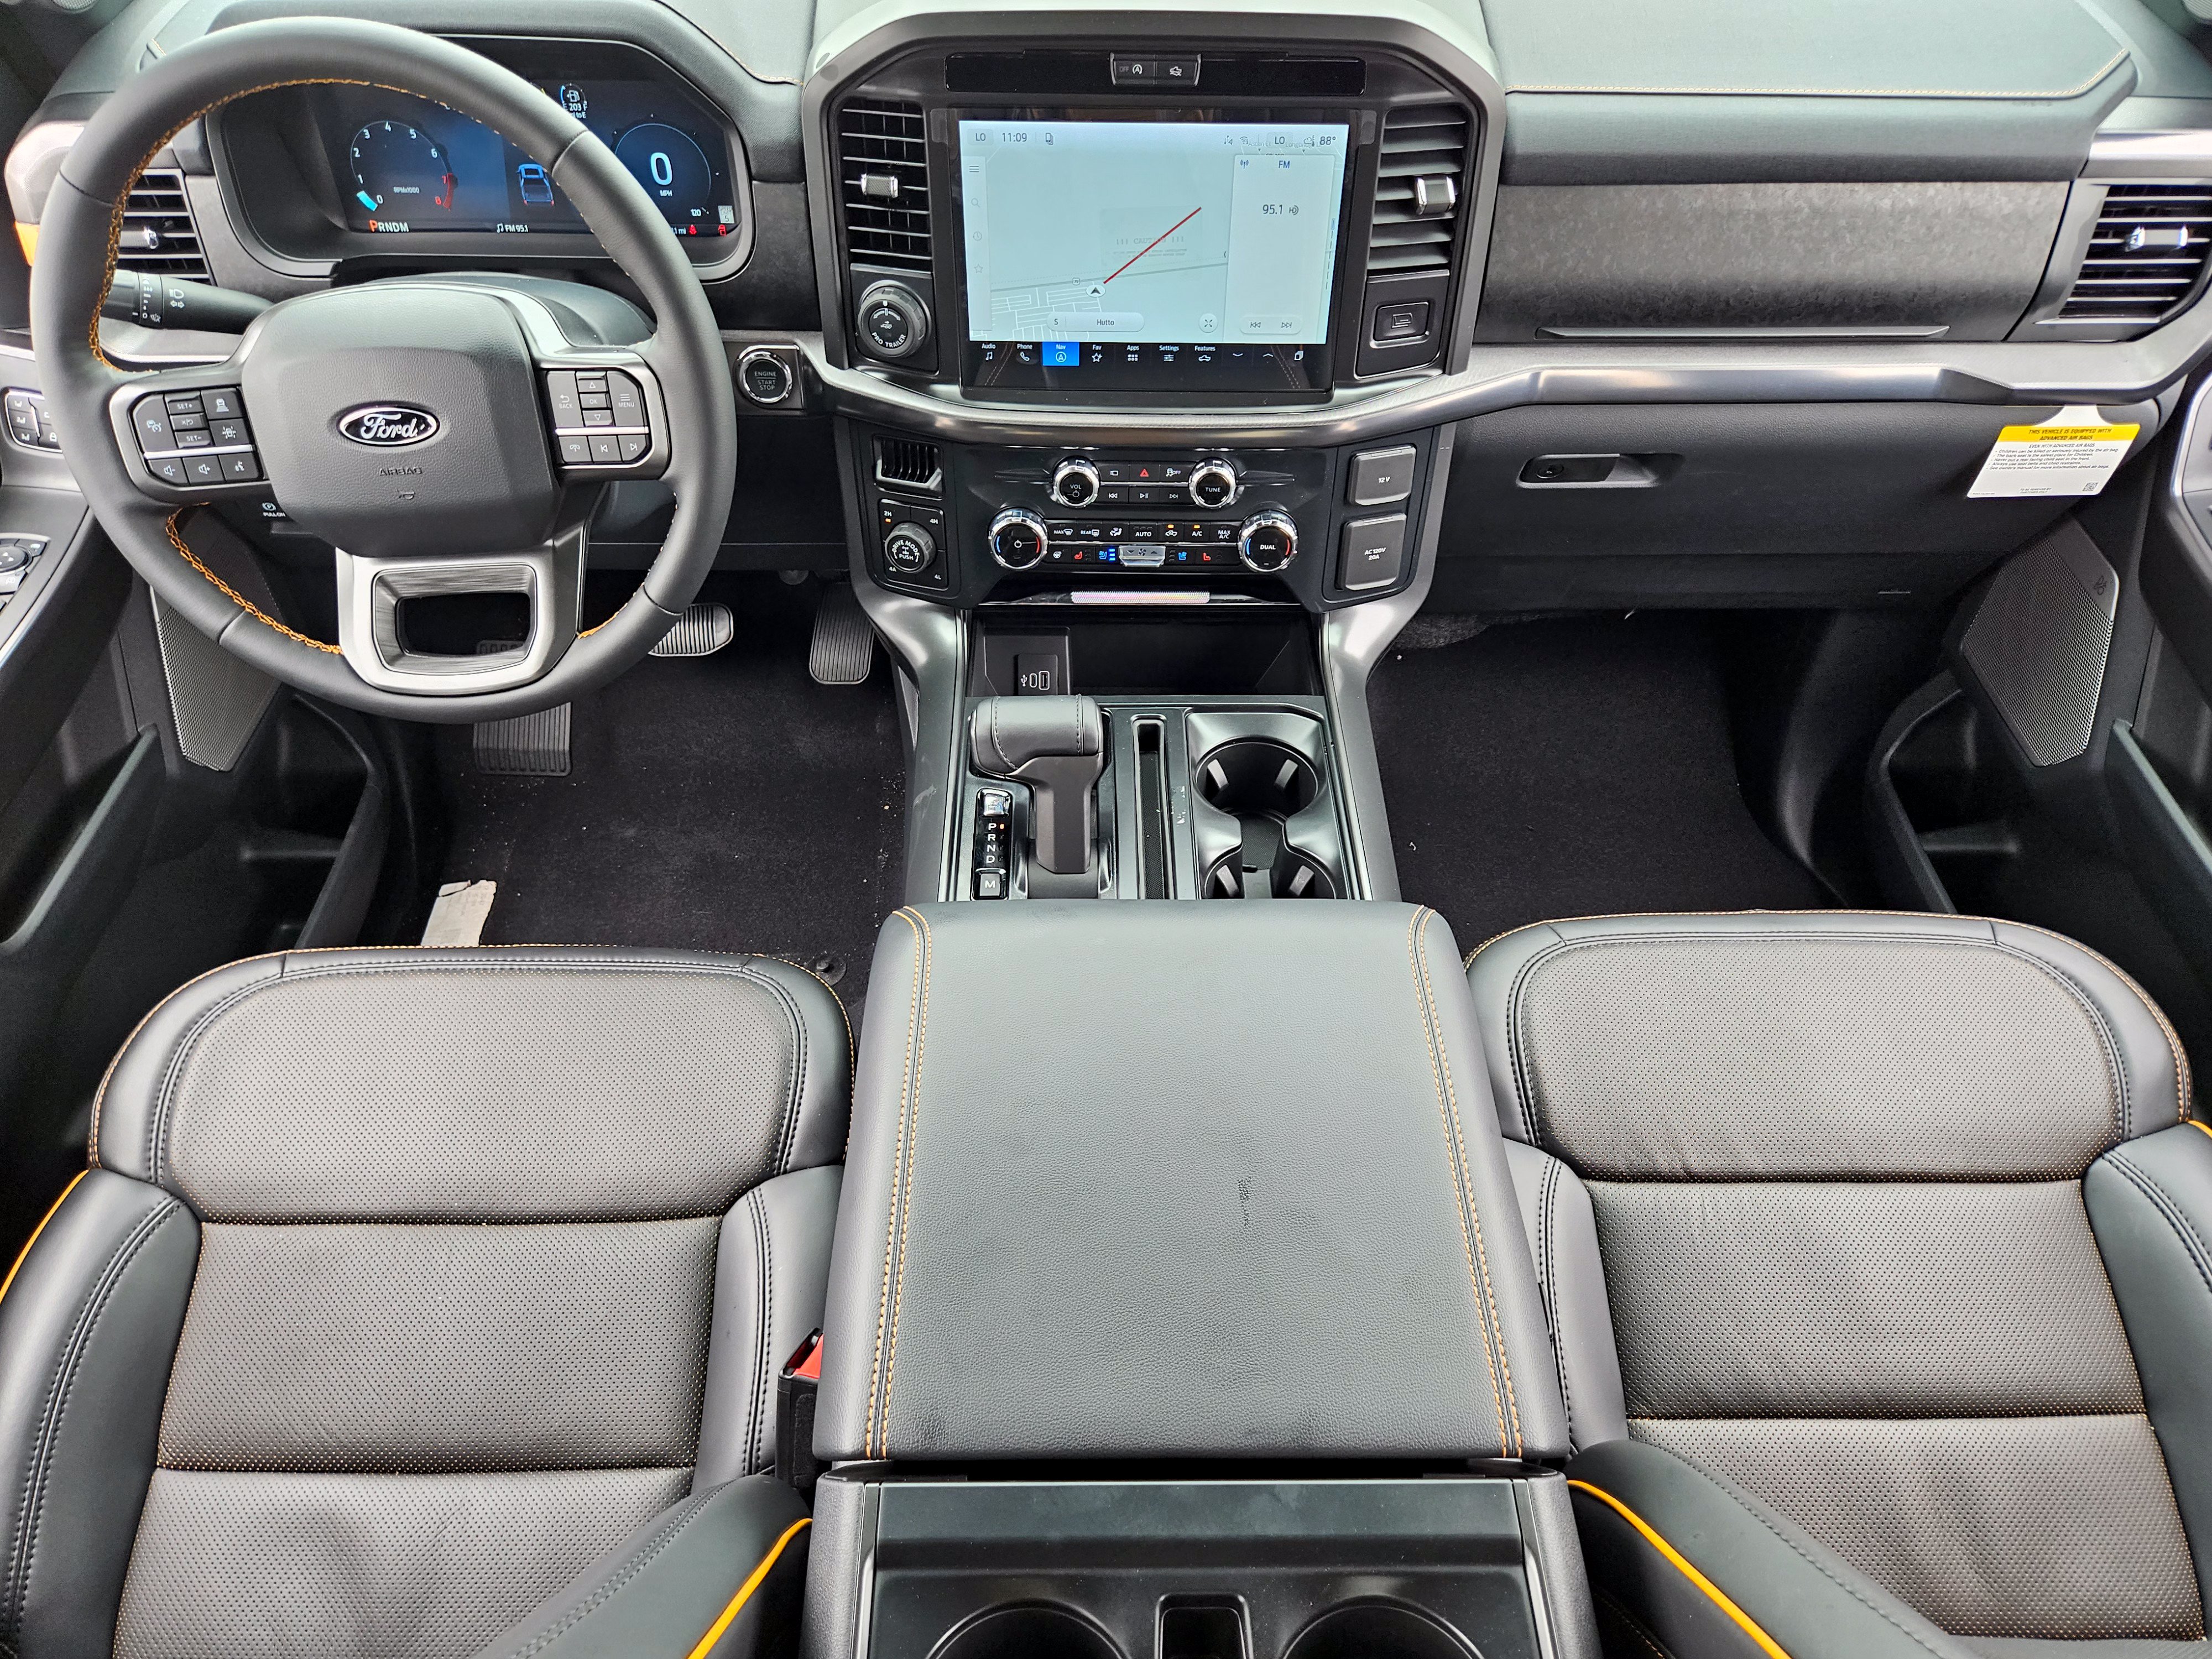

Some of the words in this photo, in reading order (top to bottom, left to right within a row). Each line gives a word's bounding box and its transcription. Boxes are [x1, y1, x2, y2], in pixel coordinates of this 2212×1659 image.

[569, 103, 582, 111] 203
[385, 121, 391, 132] 4
[363, 129, 370, 139] 3
[410, 128, 416, 139] 5
[975, 133, 986, 141] LO
[1002, 133, 1027, 142] 11:09
[1274, 136, 1285, 144] LO
[353, 148, 360, 157] 2
[431, 148, 437, 158] 6
[651, 152, 672, 185] 0
[1278, 160, 1290, 169] FM
[358, 174, 363, 184] 1
[377, 195, 383, 204] 0
[1262, 205, 1282, 215] 95.1
[872, 332, 883, 345] PRO
[885, 334, 906, 348] TRAILER
[361, 413, 418, 439] Ford
[891, 539, 904, 552] DRIVE
[905, 540, 920, 556] MODE
